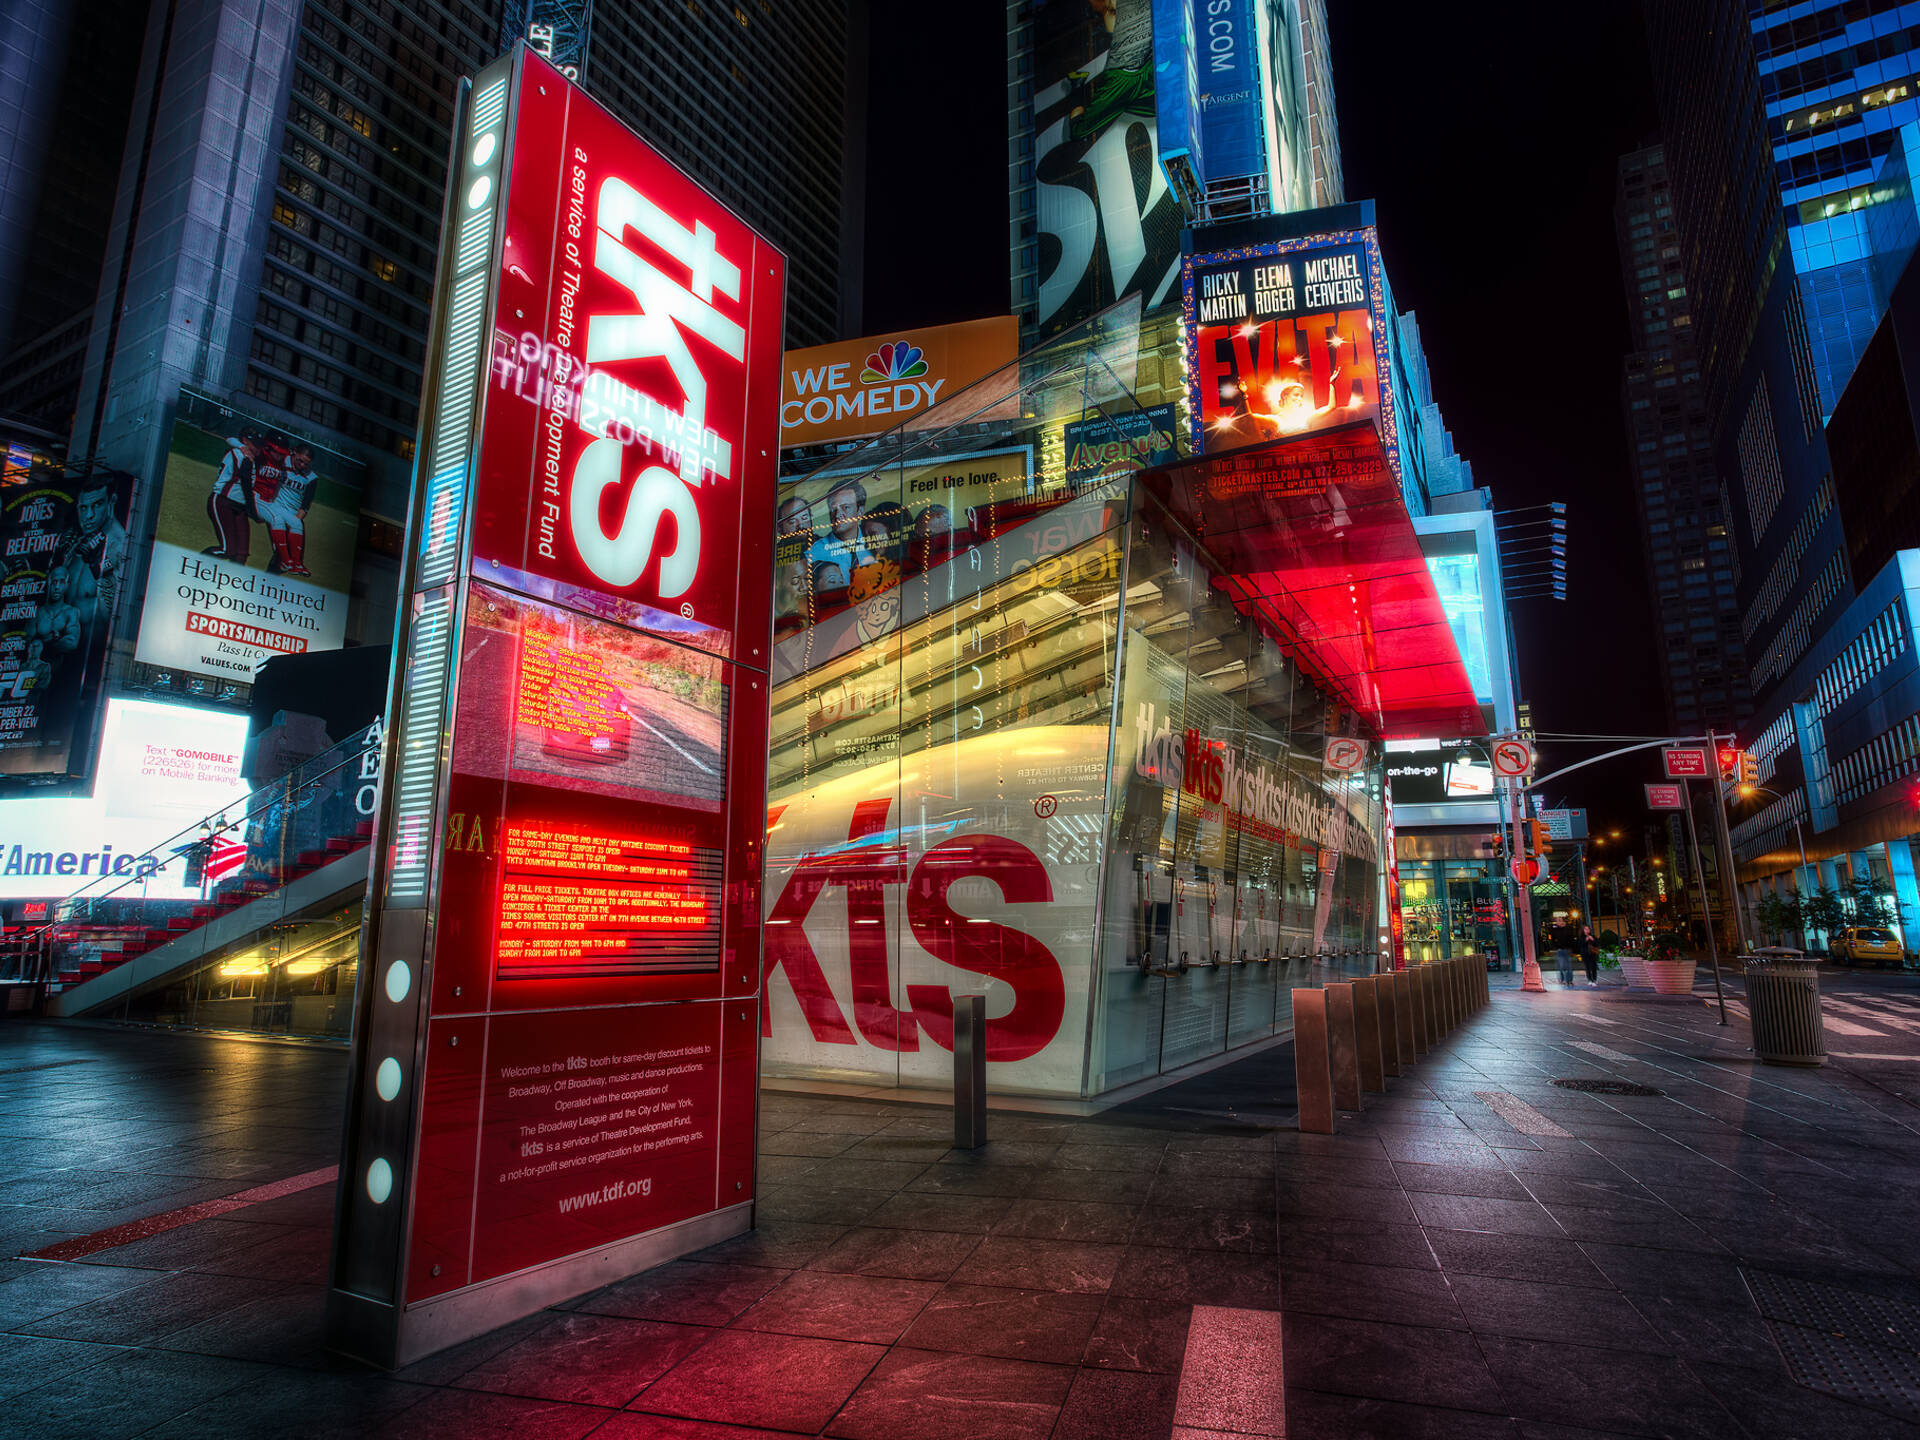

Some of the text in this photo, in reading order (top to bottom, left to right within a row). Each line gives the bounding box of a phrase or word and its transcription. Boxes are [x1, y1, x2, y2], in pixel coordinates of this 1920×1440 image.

[1208, 90, 1250, 105] ARGENT
[1254, 264, 1292, 290] ELENA
[1305, 255, 1360, 284] MICHAEL
[1203, 271, 1240, 298] RICKY
[1305, 278, 1364, 308] CERVERIS
[1200, 294, 1247, 322] MARTIN
[1255, 288, 1295, 315] ROGER
[539, 147, 587, 559] a service of Theatre Development Fund
[1198, 309, 1379, 422] EVITA
[570, 175, 746, 600] tkts
[792, 362, 850, 396] WE
[781, 378, 946, 428] COMEDY
[910, 470, 1001, 493] Feel the love.
[1213, 470, 1300, 488] TICKETMASTER.COM
[19, 502, 54, 523] JONES
[6, 533, 58, 556] BELFORT
[0, 581, 46, 598] BENAVIDEZ
[179, 556, 326, 611] Helped injured
[0, 606, 37, 620] JOHNSON
[178, 585, 320, 632] opponent win.
[190, 614, 305, 653] SPORTSMANSHIP
[216, 641, 251, 658] Pass It
[201, 656, 251, 672] VALUES.COM
[24, 706, 35, 716] 22
[144, 755, 239, 773] (226526) for more
[146, 745, 167, 756] Text
[142, 767, 155, 775] on
[159, 767, 194, 780] Mobile
[1184, 728, 1223, 804] tkts
[1387, 766, 1438, 776] on-the-go
[3, 844, 160, 877] America
[1178, 877, 1217, 906] 2 3
[501, 1045, 711, 1078] Welcome to the tkts booth for same-day discount tickets to
[509, 1068, 666, 1098] Broadway, Off Broadway, music and dance
[554, 1084, 669, 1112] Operated with the cooperation of
[520, 1126, 536, 1137] The
[537, 1119, 578, 1134] Broadway
[579, 1114, 608, 1127] League
[609, 1111, 623, 1121] and
[625, 1107, 637, 1118] the
[638, 1105, 651, 1116] City
[652, 1103, 660, 1113] of
[661, 1101, 676, 1111] New
[521, 1141, 544, 1157] tkts
[546, 1143, 553, 1152] is
[554, 1142, 561, 1151] a
[562, 1135, 590, 1149] service
[591, 1134, 600, 1145] of
[601, 1128, 628, 1141] Theatre
[629, 1119, 673, 1136] Development
[500, 1175, 506, 1183] a
[508, 1161, 558, 1181] not-for-profit
[559, 1156, 587, 1170] service
[588, 1146, 632, 1164] organization
[632, 1143, 643, 1153] for
[643, 1140, 655, 1150] the
[655, 1134, 690, 1150] performing
[559, 1177, 651, 1214] www.tdf.org
